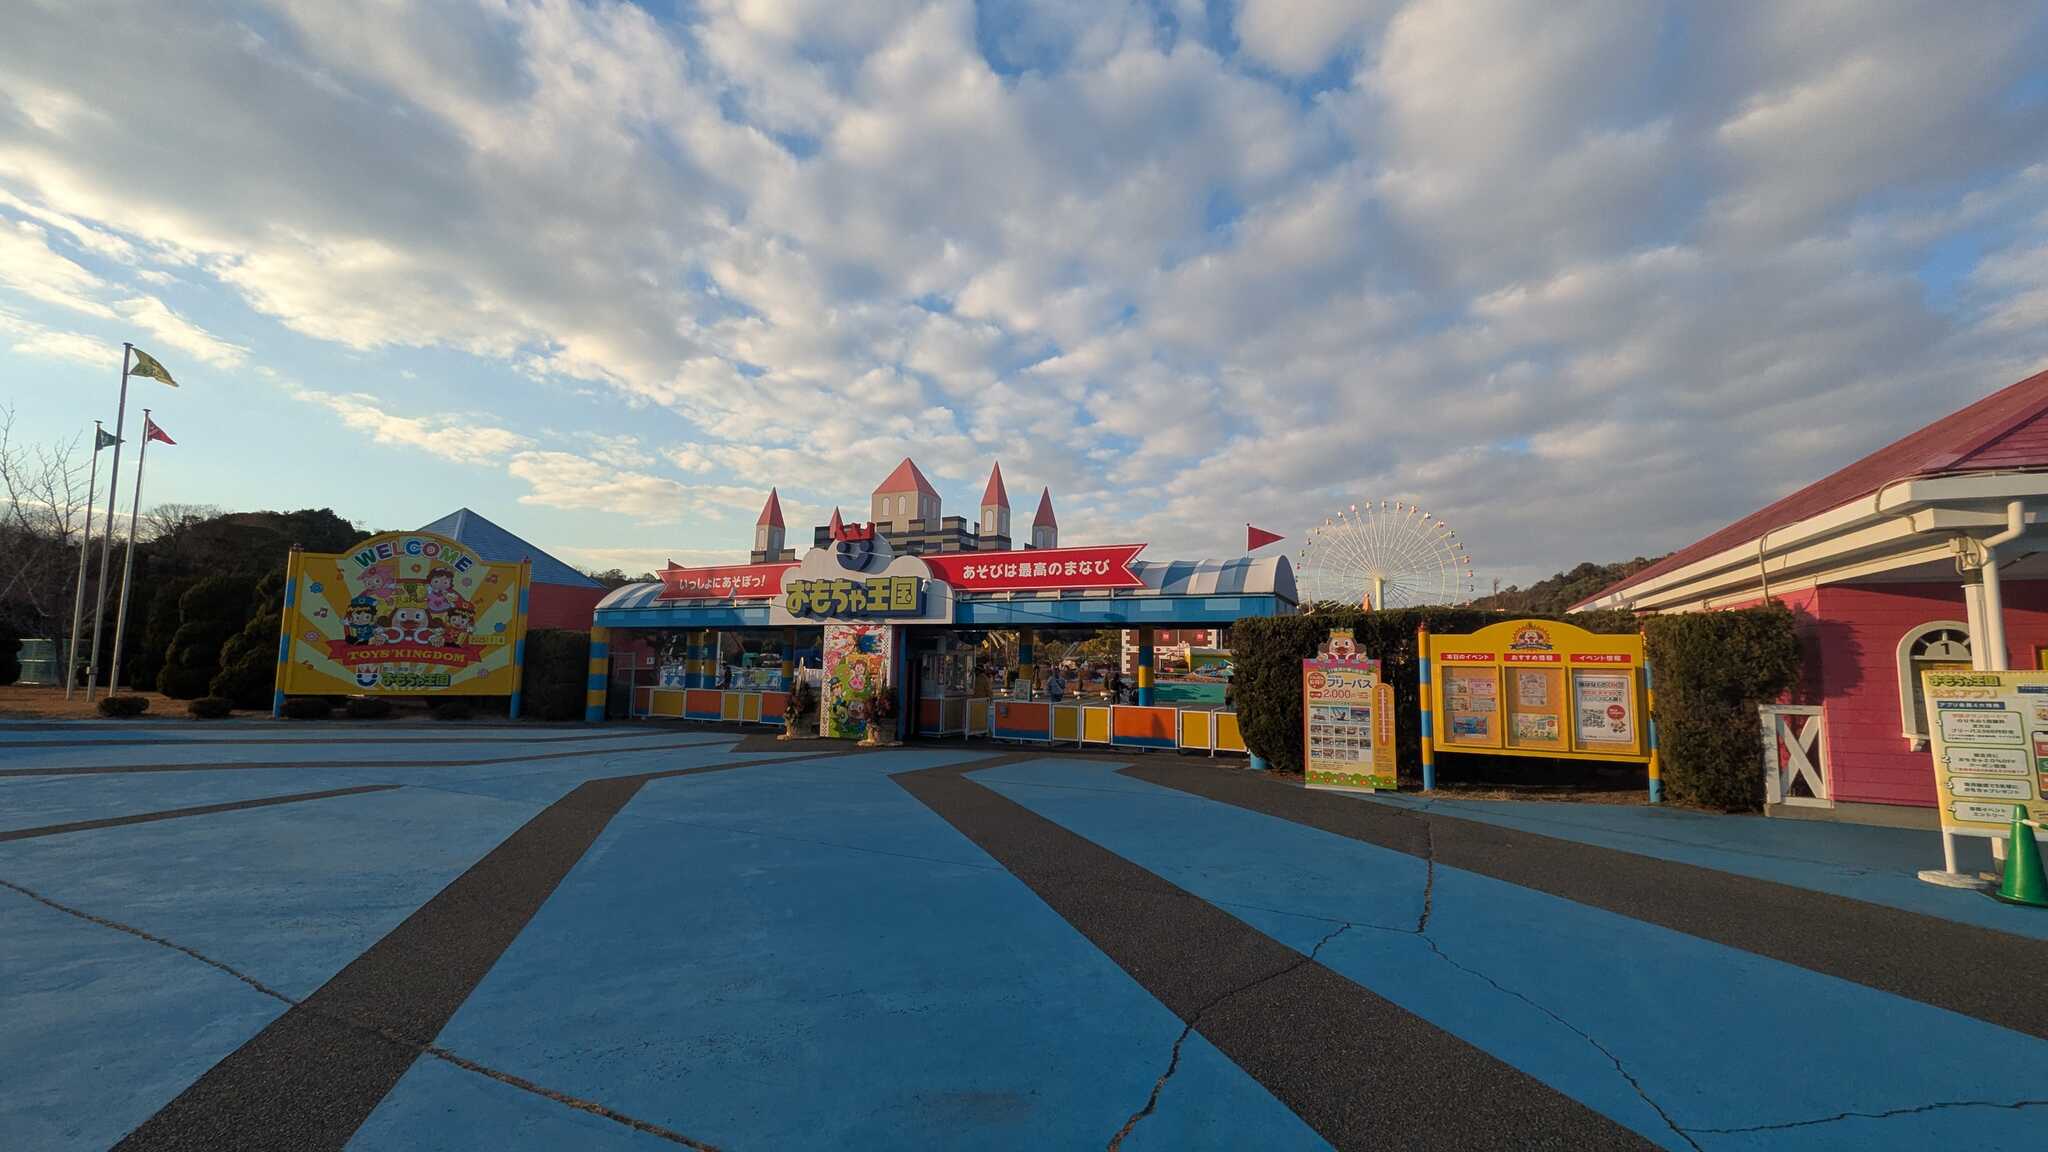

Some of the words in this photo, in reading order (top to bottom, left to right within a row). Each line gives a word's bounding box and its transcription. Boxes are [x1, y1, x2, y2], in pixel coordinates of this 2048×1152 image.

[354, 540, 474, 574] WELCOME
[962, 558, 1110, 581] あそびは最高のまなび
[679, 573, 767, 591] いっしょにあそぼっ!
[785, 575, 920, 616] おもちゃ王国
[394, 648, 466, 664] KINGDOM
[1940, 643, 1950, 655] 1
[382, 672, 451, 687] おもちゃ王国
[1327, 678, 1373, 689] フリーパス
[1931, 675, 2000, 687] おもちゃ王国
